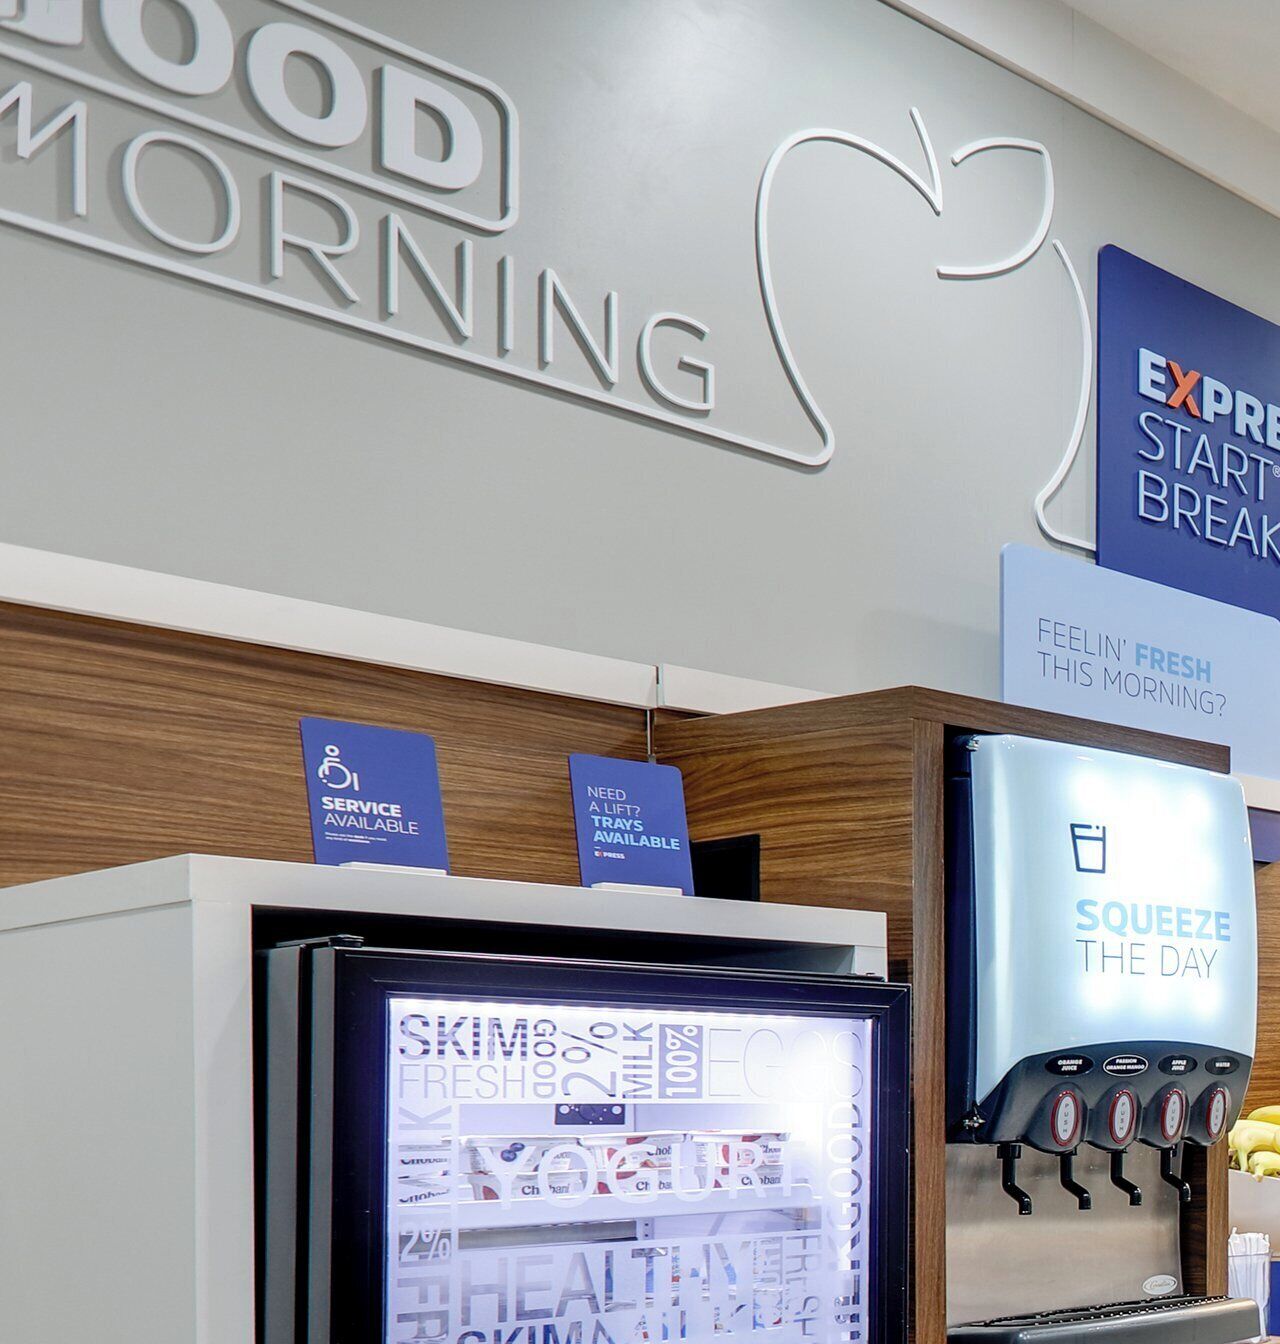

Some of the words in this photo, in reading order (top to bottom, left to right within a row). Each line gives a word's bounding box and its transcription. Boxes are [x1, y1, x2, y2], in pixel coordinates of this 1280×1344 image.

[1037, 650, 1093, 687] THIS
[1103, 666, 1228, 718] MORNING?
[1134, 642, 1212, 684] FRESH
[321, 796, 402, 818] SERVICE
[586, 785, 627, 801] NEED
[589, 801, 600, 813] A
[604, 802, 641, 818] LIFT?
[323, 812, 420, 836] AVAILABLE
[591, 815, 644, 832] TRAYS
[593, 830, 681, 851] AVAILABLE
[1075, 898, 1232, 942] SQUEEZE
[1075, 938, 1145, 976] THE
[1160, 945, 1219, 979] DAY
[398, 1013, 529, 1062] SKIM
[532, 1018, 557, 1099] GOOD
[560, 1021, 619, 1098] 2%
[622, 1021, 654, 1099] MILK
[664, 1024, 700, 1097] 100%
[398, 1063, 527, 1100] FRESH
[476, 1140, 806, 1209] YOGURT
